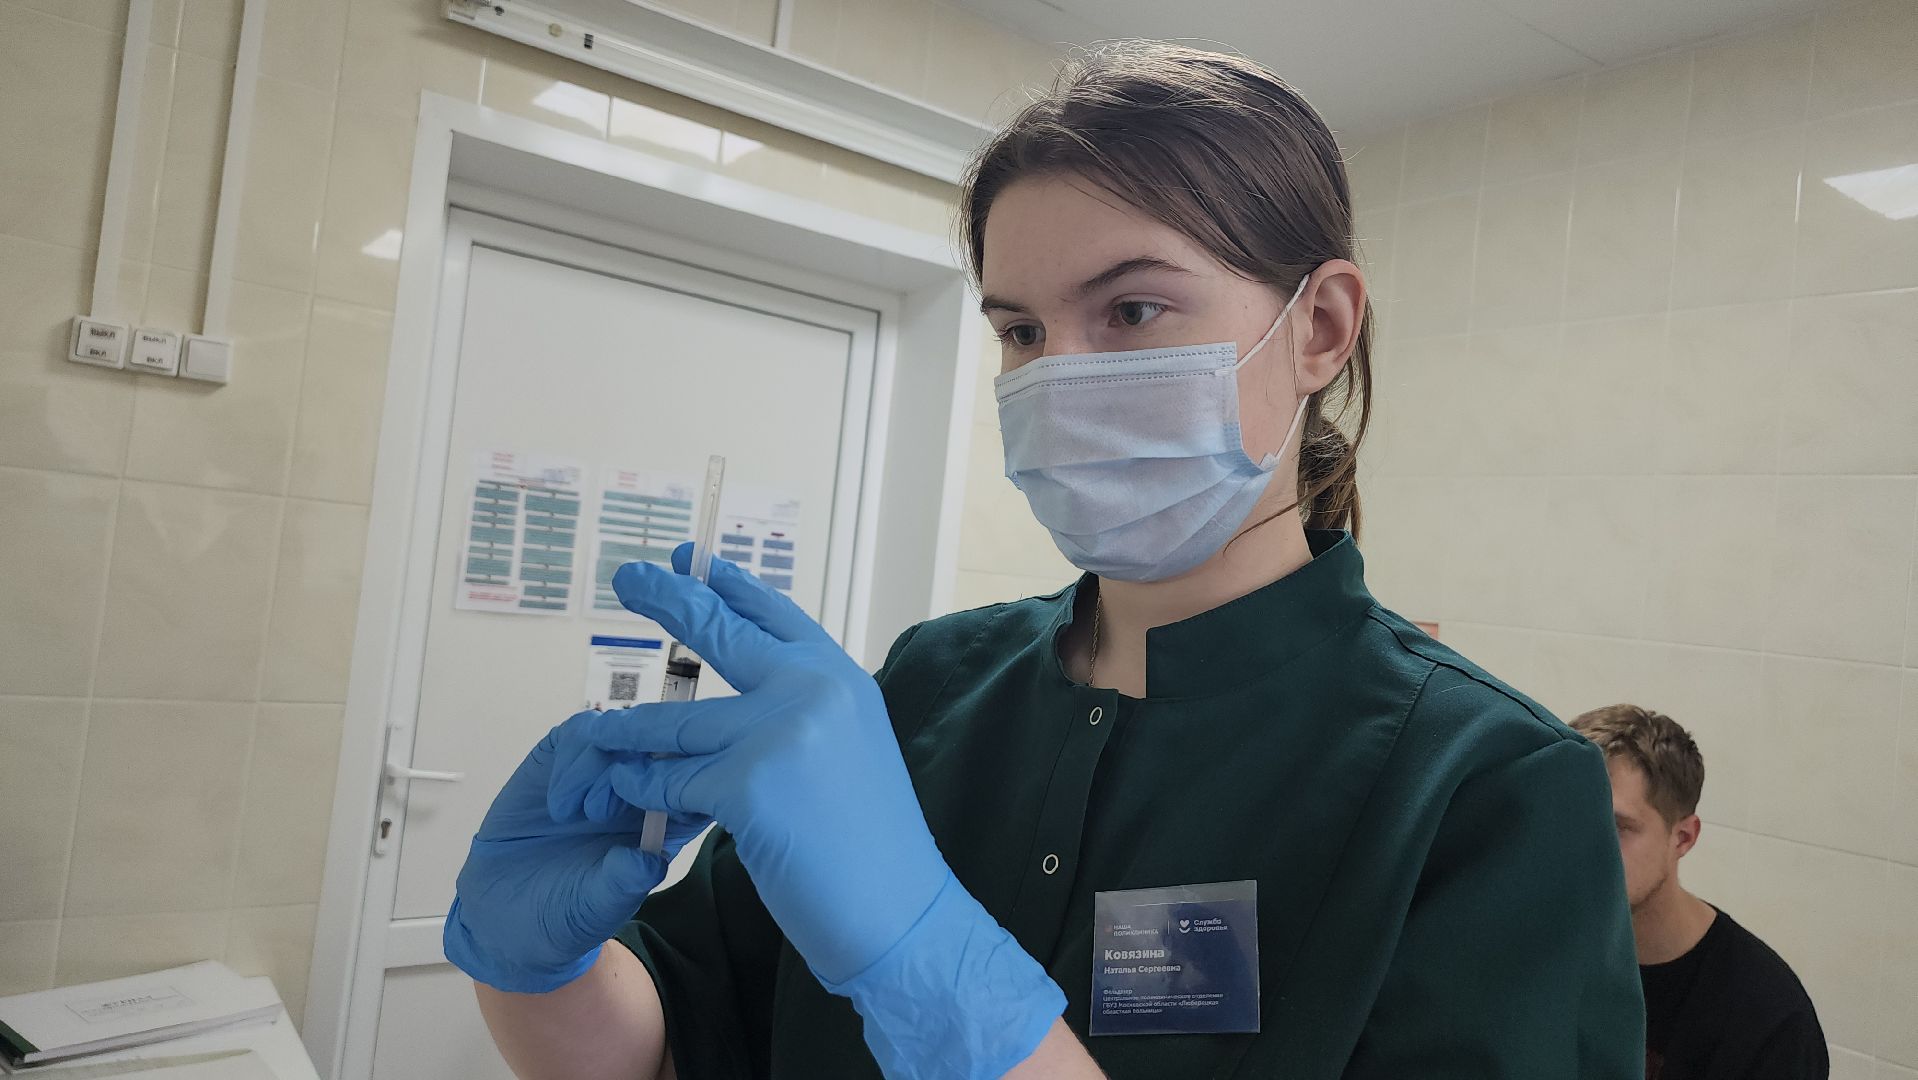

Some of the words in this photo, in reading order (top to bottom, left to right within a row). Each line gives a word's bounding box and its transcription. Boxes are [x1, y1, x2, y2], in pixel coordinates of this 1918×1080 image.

[673, 681, 679, 691] 1
[1104, 949, 1165, 961] Ковязина
[1103, 966, 1137, 975] Наталья
[1138, 964, 1181, 974] Сергеевна
